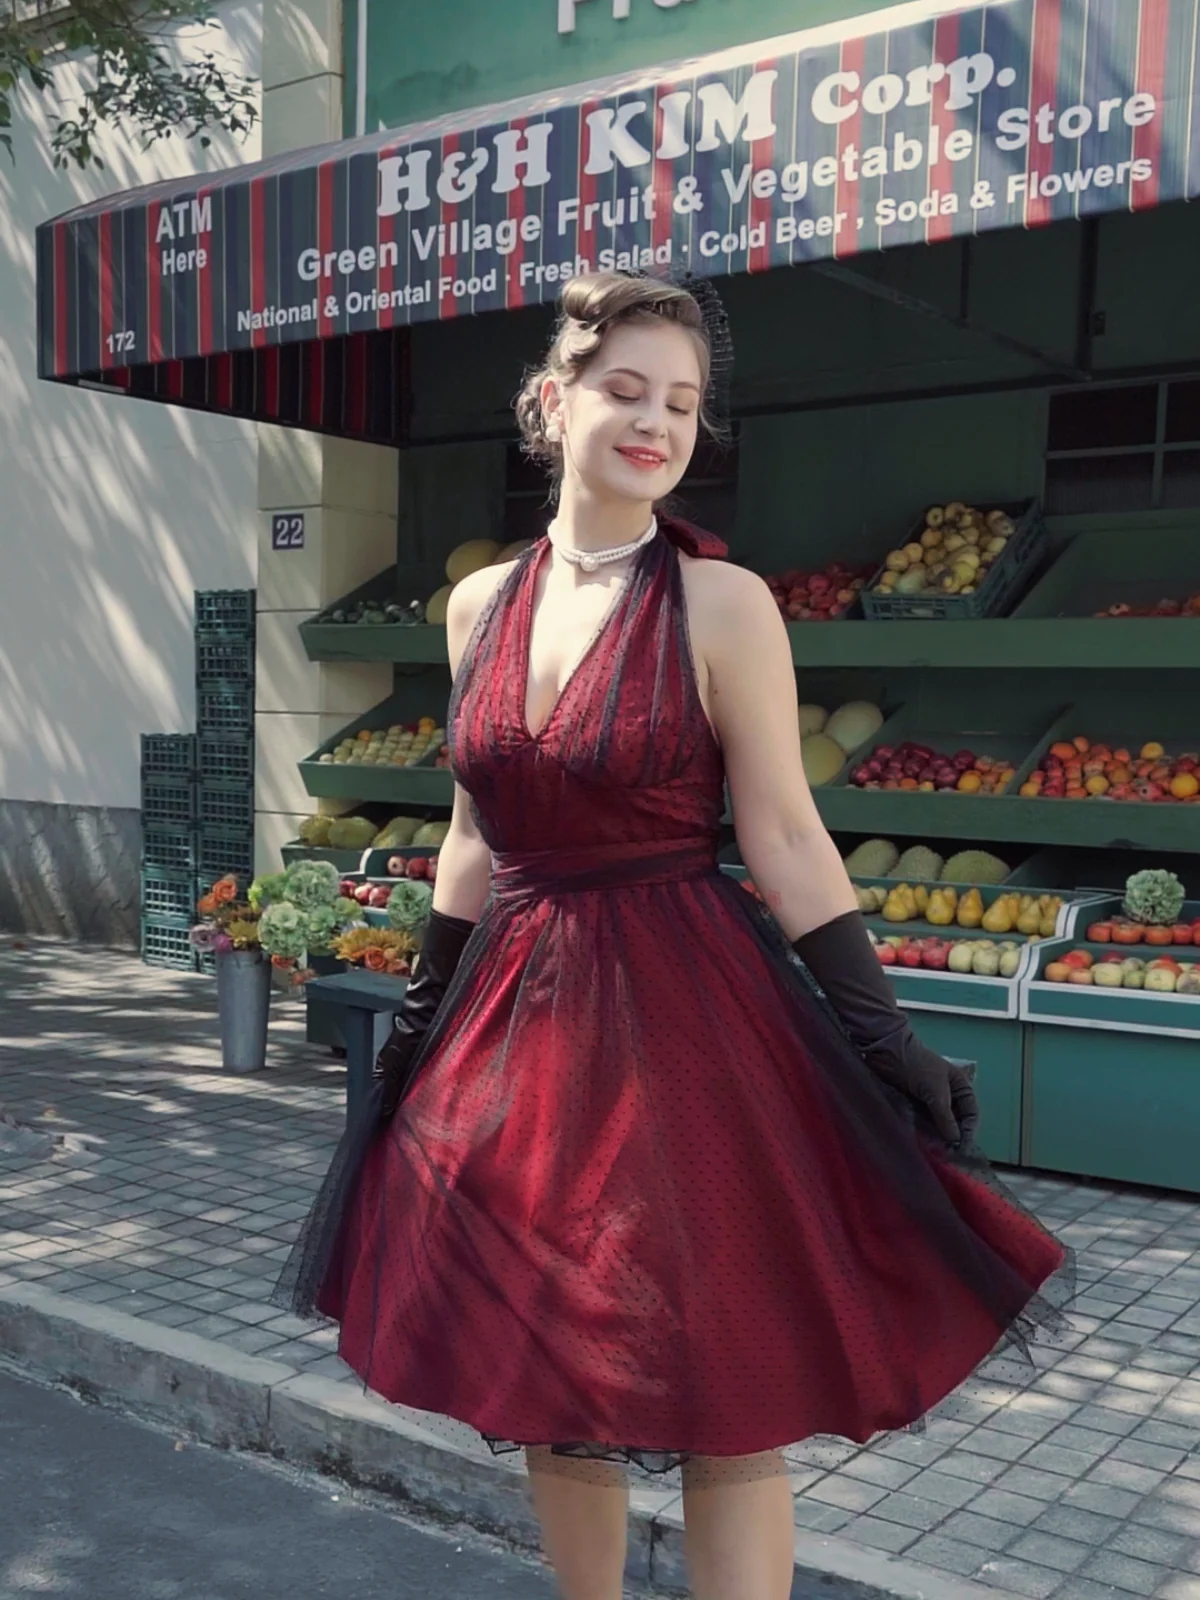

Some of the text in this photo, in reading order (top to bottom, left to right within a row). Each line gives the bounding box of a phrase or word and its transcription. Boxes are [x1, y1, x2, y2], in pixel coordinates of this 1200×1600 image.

[378, 51, 1017, 217] H&H KIM Corp.
[297, 92, 1156, 281] Green Village Fruit & Vegetable Store
[155, 197, 212, 243] ATM
[162, 248, 207, 276] Here
[237, 298, 318, 332] National
[323, 297, 340, 319] &
[345, 282, 430, 314] Oriental
[438, 268, 497, 299] Food
[519, 254, 590, 287] Fresh
[598, 239, 672, 272] Salad
[700, 225, 767, 258] Cold
[776, 212, 848, 245] Beer
[874, 189, 959, 226] Soda
[970, 180, 996, 210] &
[1007, 158, 1153, 203] Flowers
[106, 330, 136, 353] 172
[276, 518, 303, 545] 22
